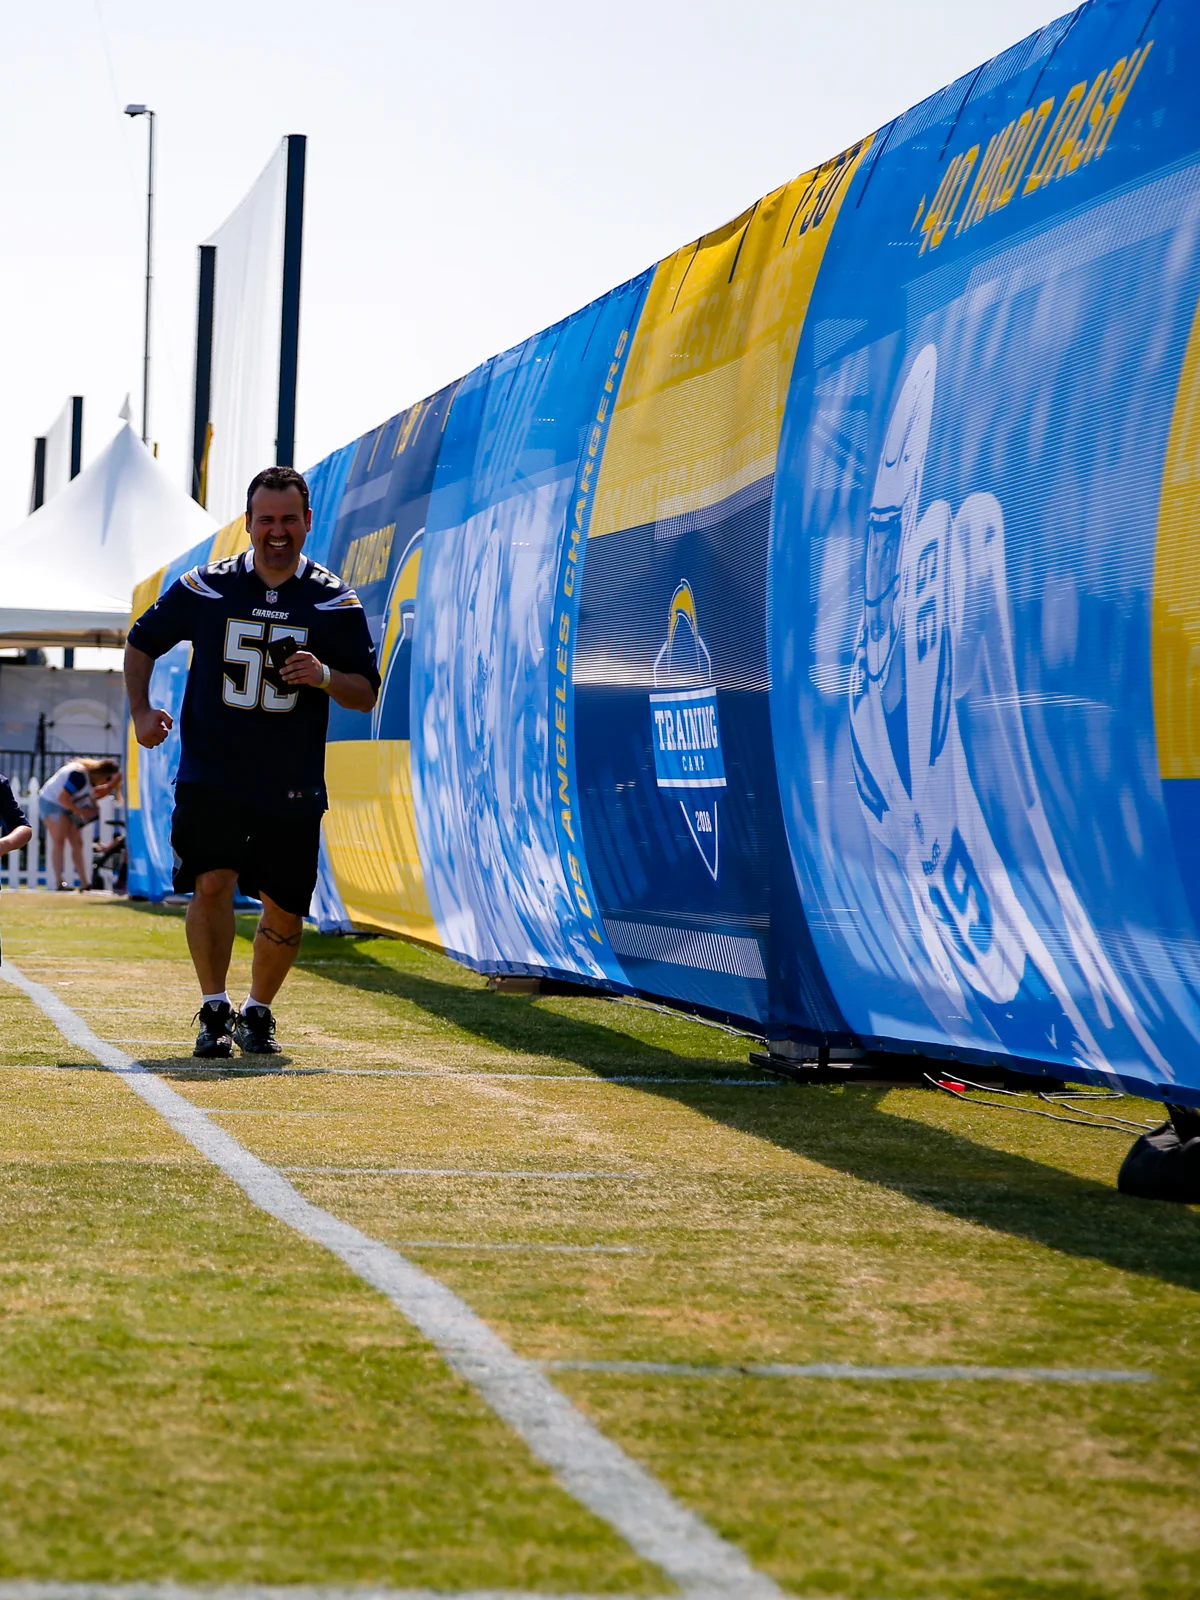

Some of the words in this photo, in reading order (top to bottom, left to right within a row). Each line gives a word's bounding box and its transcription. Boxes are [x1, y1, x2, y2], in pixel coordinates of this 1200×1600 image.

[919, 143, 980, 256] 40
[955, 96, 1055, 238] YARD
[1022, 40, 1154, 197] DASH
[563, 329, 629, 598] CHARGERS
[251, 607, 290, 621] CHARGERS
[222, 617, 309, 713] 55
[555, 611, 576, 842] ANGELES
[654, 705, 718, 751] TRAINING
[681, 755, 705, 772] CAMP
[567, 851, 603, 945] LOS
